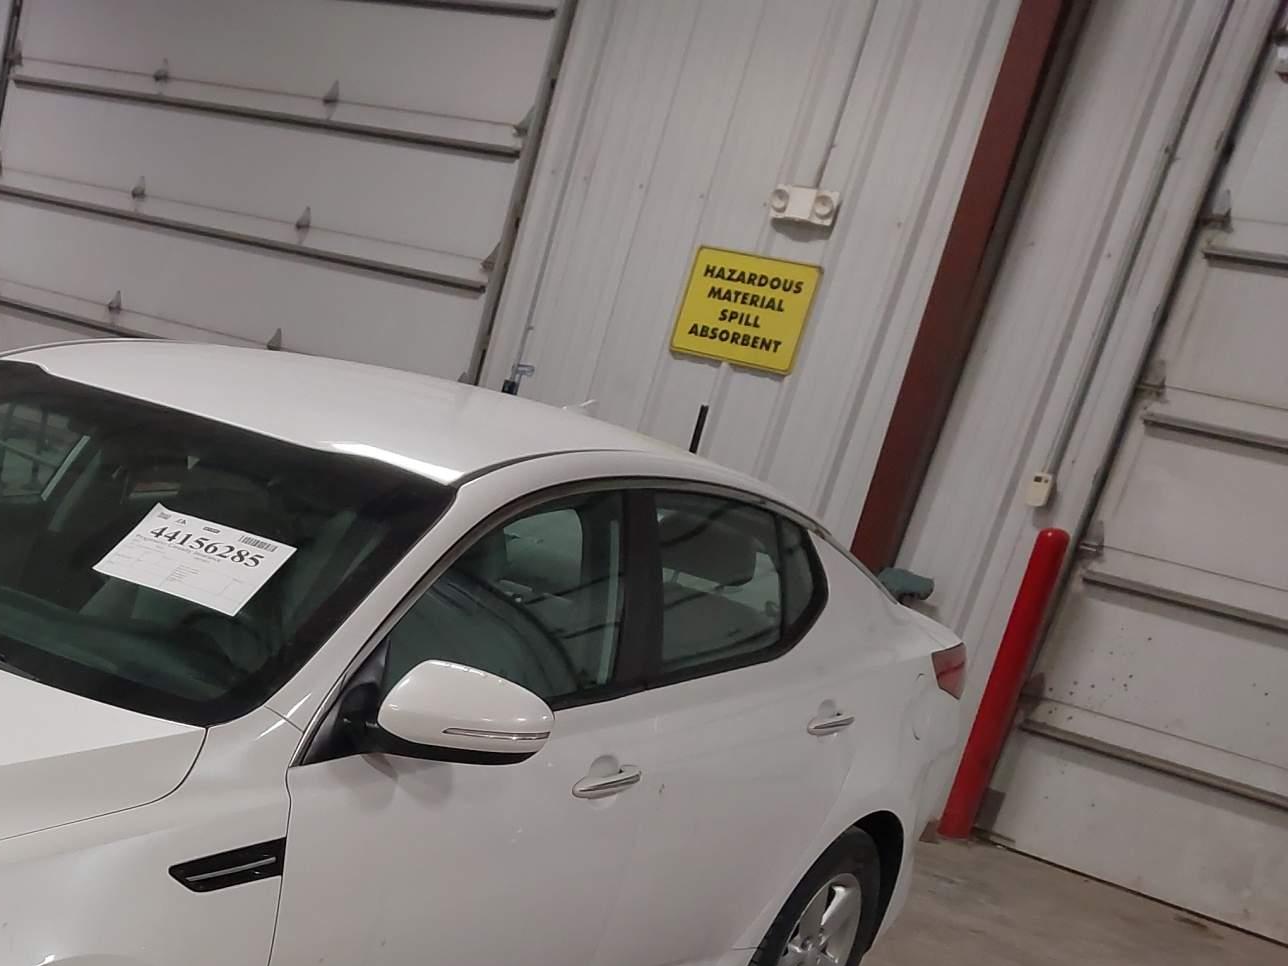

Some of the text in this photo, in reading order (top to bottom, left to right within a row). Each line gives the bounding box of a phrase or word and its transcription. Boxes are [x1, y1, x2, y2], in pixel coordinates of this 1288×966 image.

[703, 264, 804, 294] HAZARDOUS
[707, 286, 785, 312] MATERIAL
[718, 308, 761, 328] SPILL
[688, 323, 782, 353] ABSORBENT
[149, 526, 265, 568] 44156285
